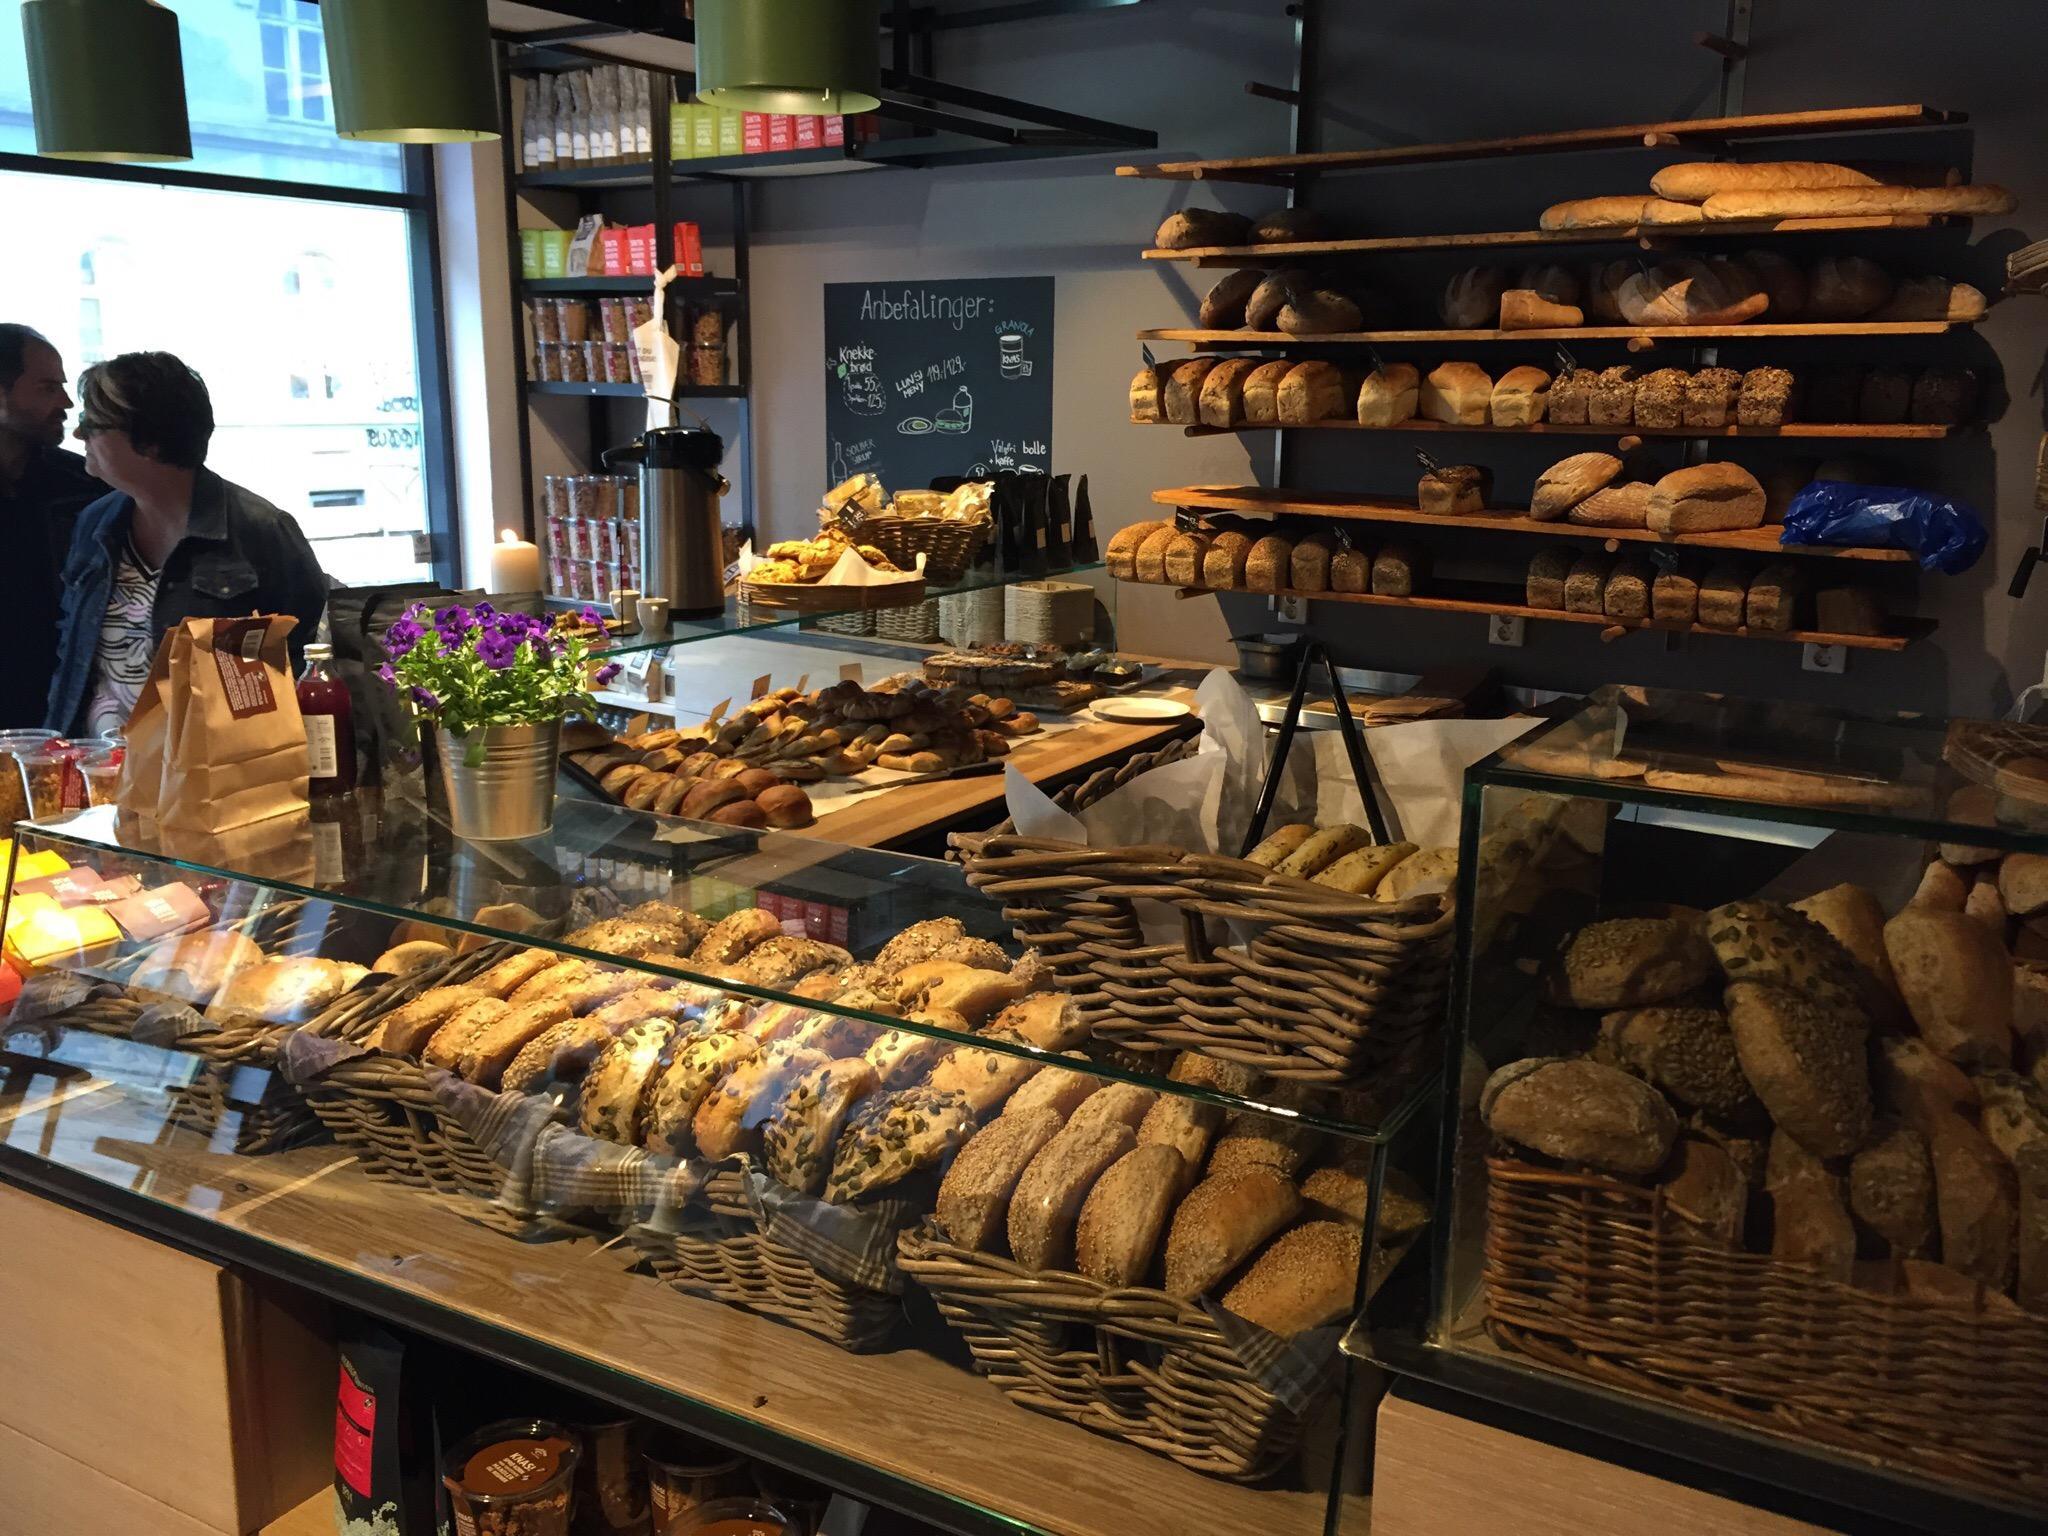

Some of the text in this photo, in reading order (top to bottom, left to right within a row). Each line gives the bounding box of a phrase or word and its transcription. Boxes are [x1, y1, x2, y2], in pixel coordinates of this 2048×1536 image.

[860, 289, 994, 331] Anbefalinger:
[994, 320, 1035, 337] GRANOLA
[903, 381, 924, 398] MENY
[1022, 440, 1046, 455] bolle
[995, 454, 1015, 467] kaffe
